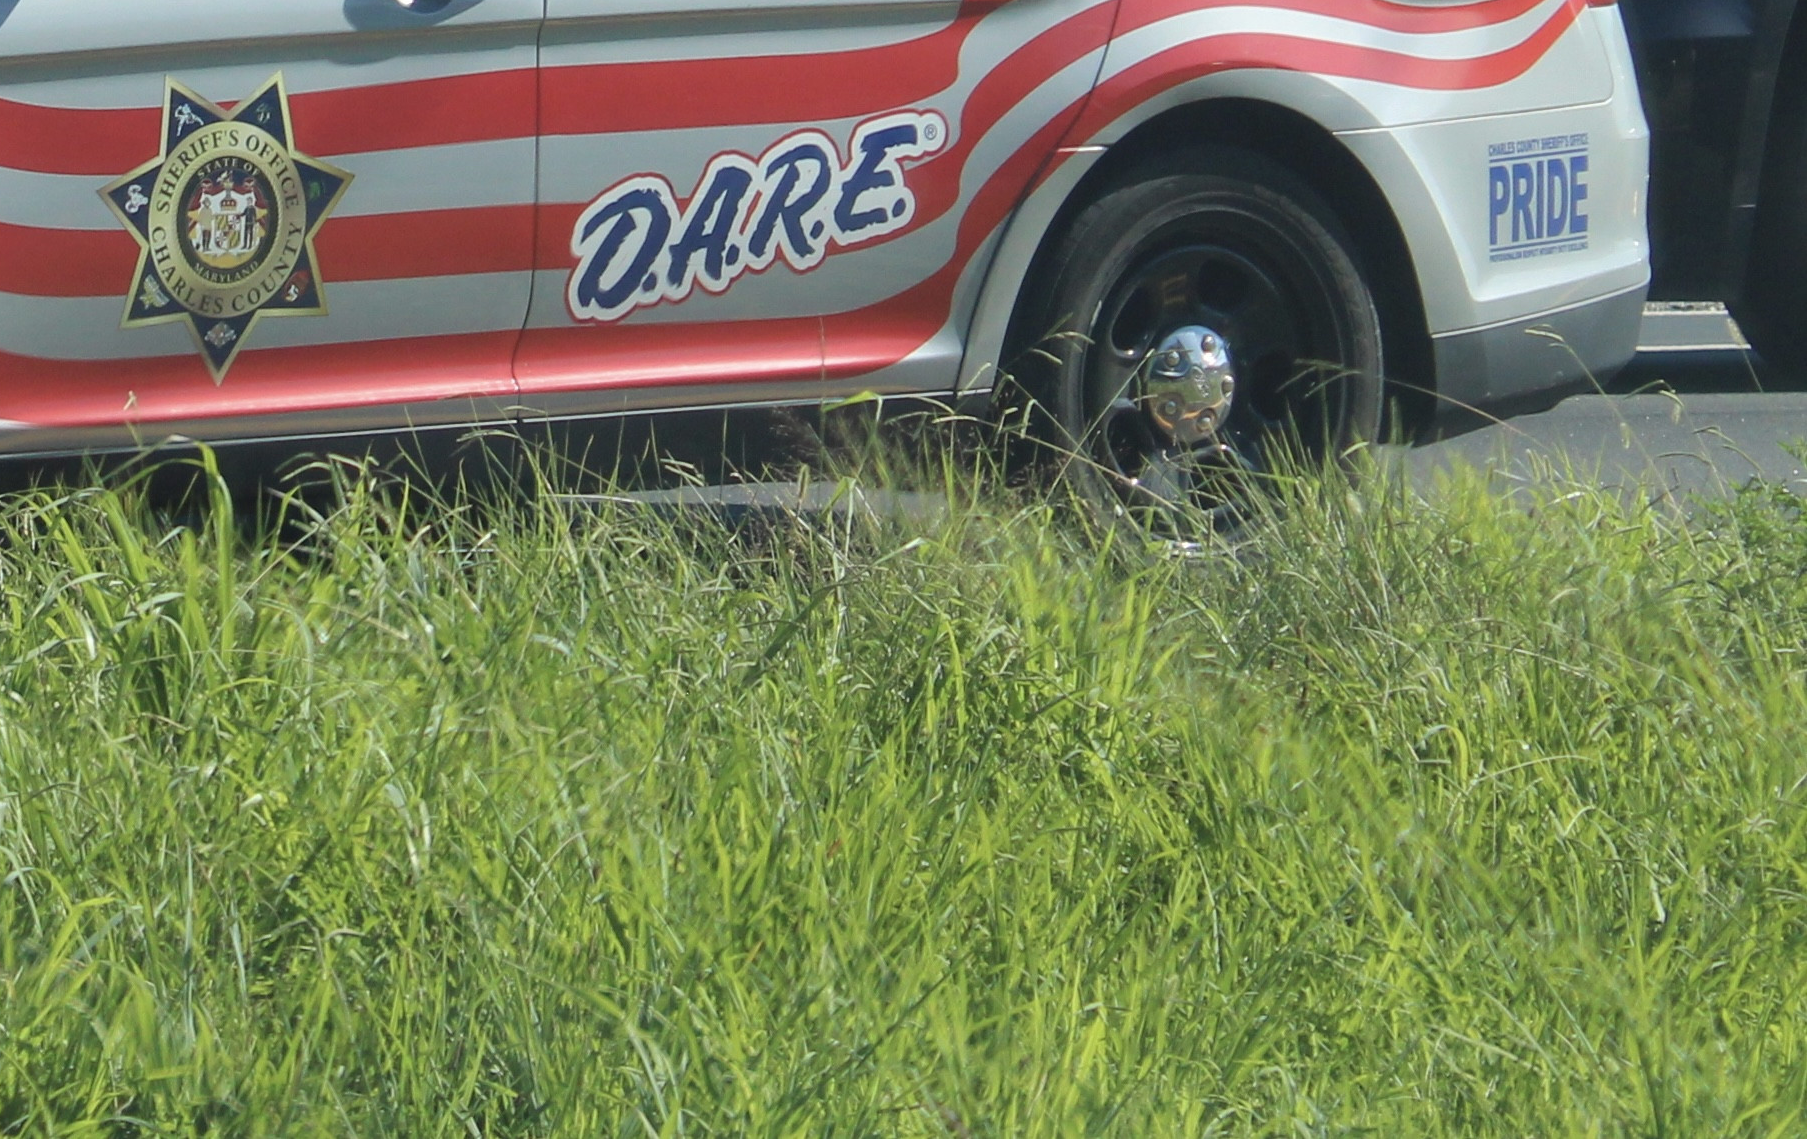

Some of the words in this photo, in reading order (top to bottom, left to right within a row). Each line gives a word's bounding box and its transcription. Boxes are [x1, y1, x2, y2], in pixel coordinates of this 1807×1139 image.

[156, 129, 240, 215] SHERIFF'S
[246, 134, 300, 209] OFFICE
[197, 157, 238, 179] STATE
[243, 163, 260, 176] OF
[1489, 155, 1589, 246] PRIDE
[151, 226, 224, 314] CHARLES
[231, 223, 302, 313] COUNTY
[194, 261, 259, 282] MARYLAND
